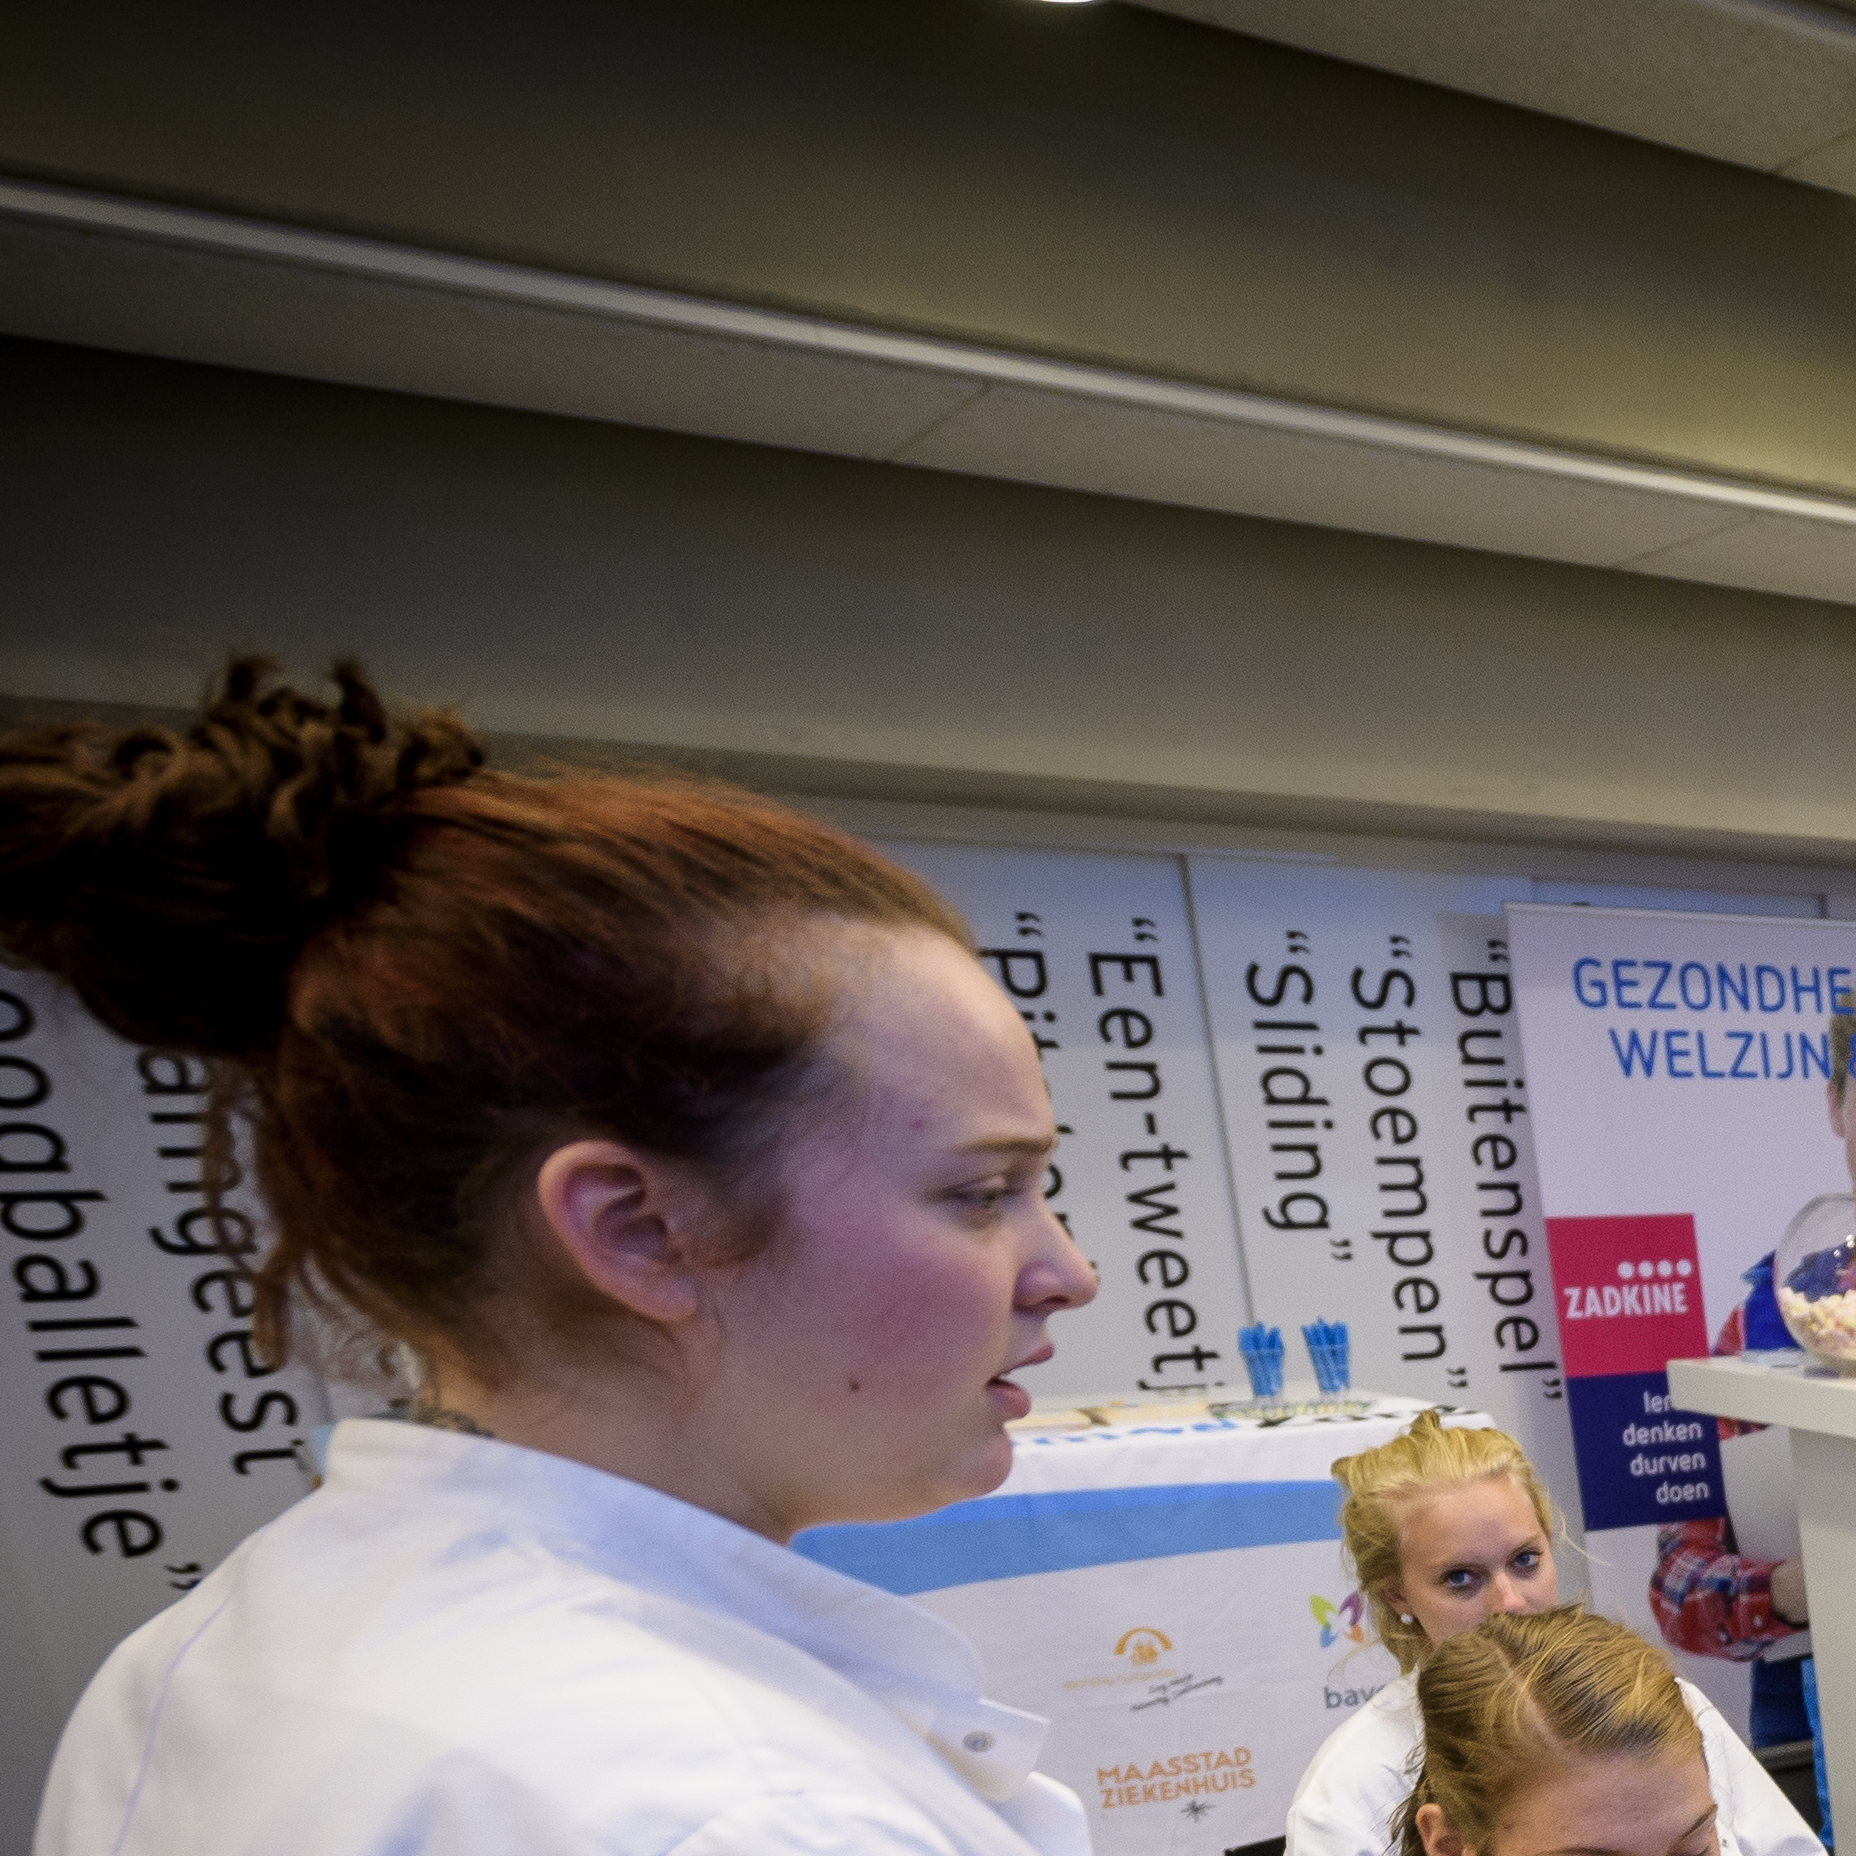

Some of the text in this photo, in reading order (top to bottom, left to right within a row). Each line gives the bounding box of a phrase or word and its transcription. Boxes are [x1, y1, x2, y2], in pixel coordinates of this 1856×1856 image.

[1610, 1028, 1831, 1080] WELZIJN
[1245, 930, 1353, 1262] “Sliding”
[1088, 916, 1225, 1391] “Een-tweetj
[1350, 935, 1468, 1389] “Stoempen”
[1449, 938, 1563, 1400] “Buitenspel”
[1564, 1281, 1689, 1320] ZADKINE
[1622, 1420, 1704, 1447] denken
[1629, 1452, 1707, 1477] durven
[1655, 1480, 1711, 1505] doen
[1096, 1747, 1253, 1786] MAASSTAD
[1102, 1768, 1256, 1809] ZIEKENHUIS
